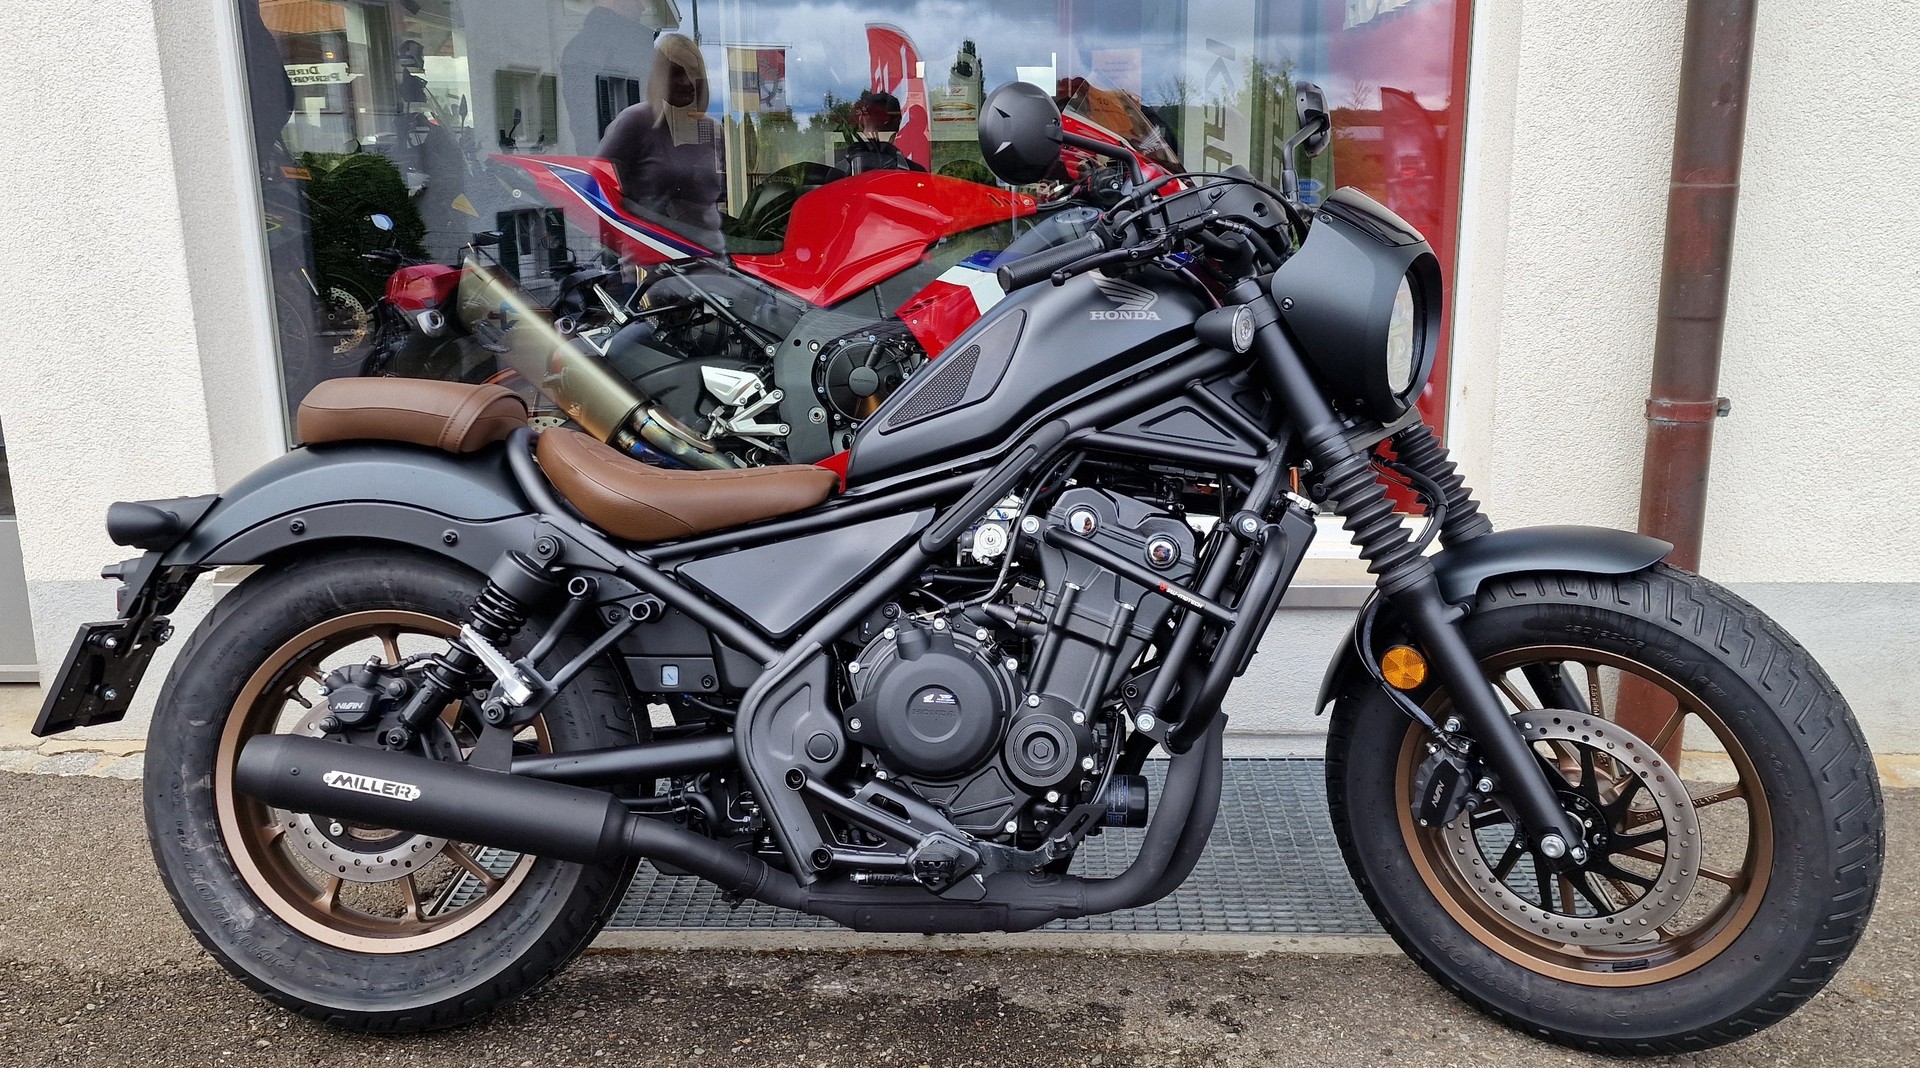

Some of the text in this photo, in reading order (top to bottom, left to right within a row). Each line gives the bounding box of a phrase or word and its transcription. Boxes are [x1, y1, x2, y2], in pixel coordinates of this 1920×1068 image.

[1090, 310, 1161, 321] HONDA
[912, 708, 956, 718] HONDA
[331, 774, 412, 799] MILLER
